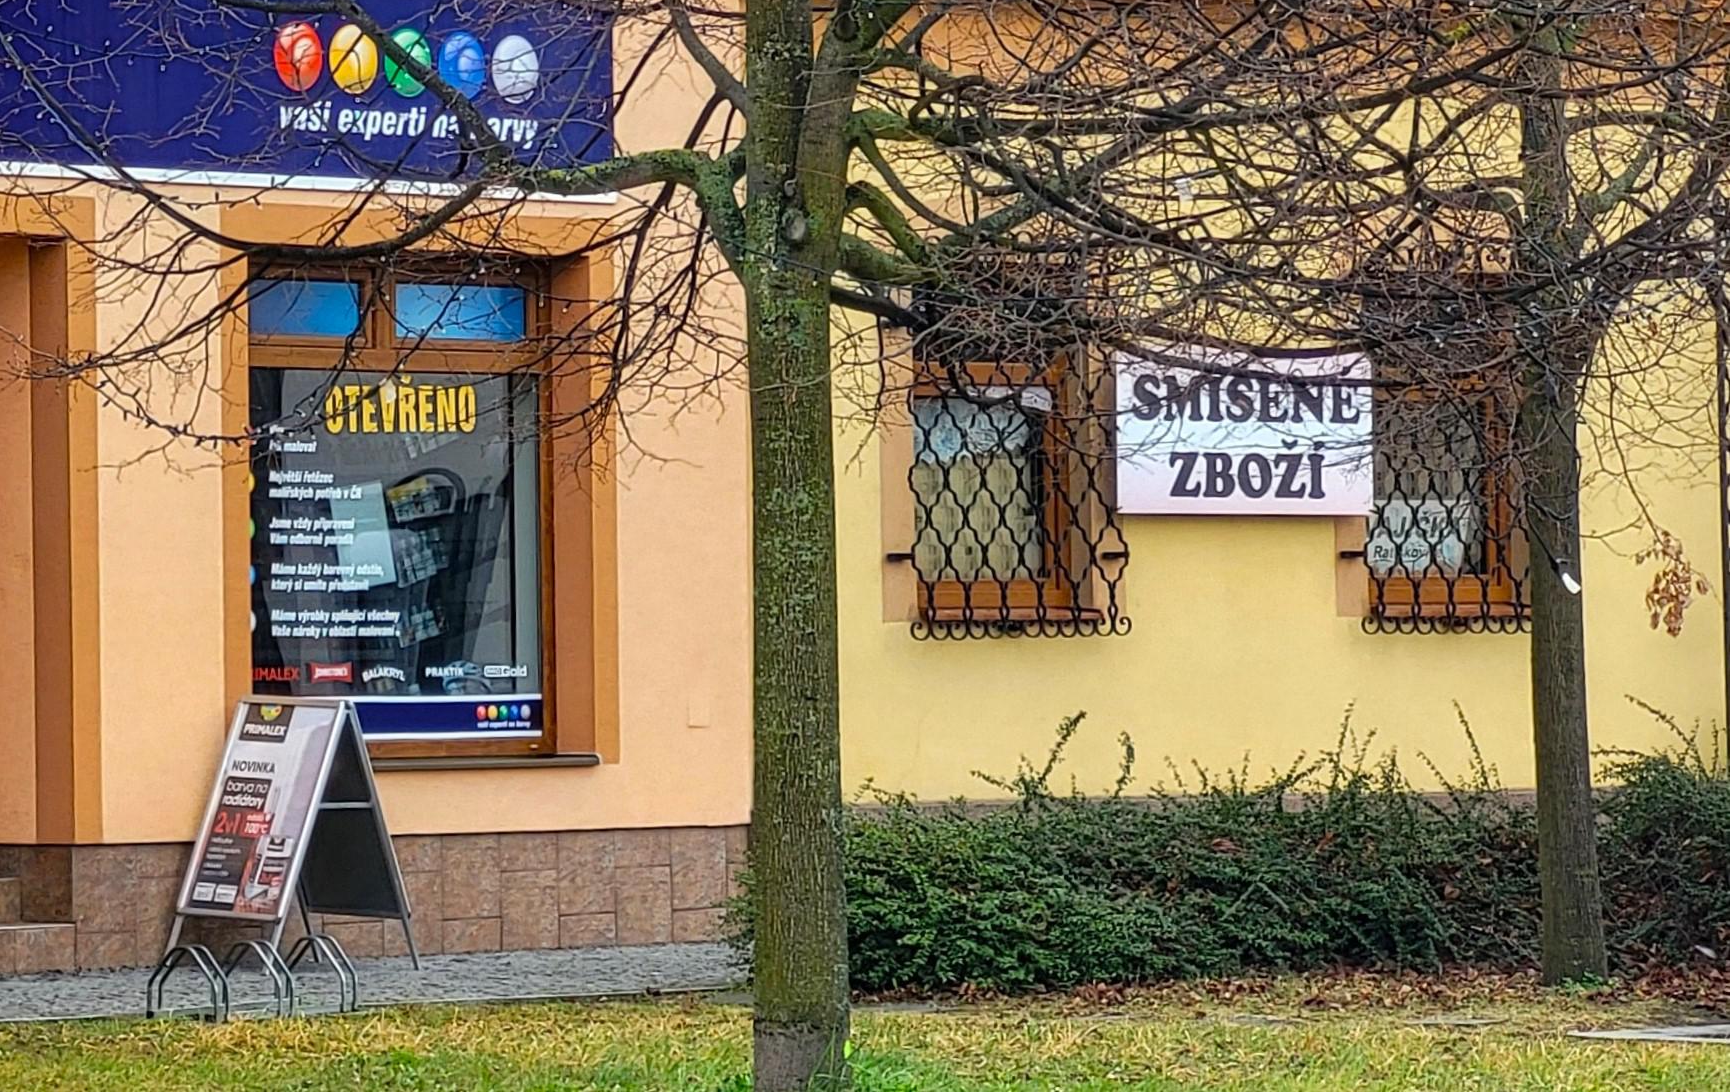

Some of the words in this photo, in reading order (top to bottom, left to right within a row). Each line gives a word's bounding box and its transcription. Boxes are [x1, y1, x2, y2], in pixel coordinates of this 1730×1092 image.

[337, 106, 427, 141] experti
[325, 374, 478, 435] OTEVŘENO
[1169, 438, 1326, 500] ZBOŽÍ
[243, 723, 287, 736] PRIMALEX
[231, 759, 275, 774] NOVINKA
[226, 779, 254, 793] barva
